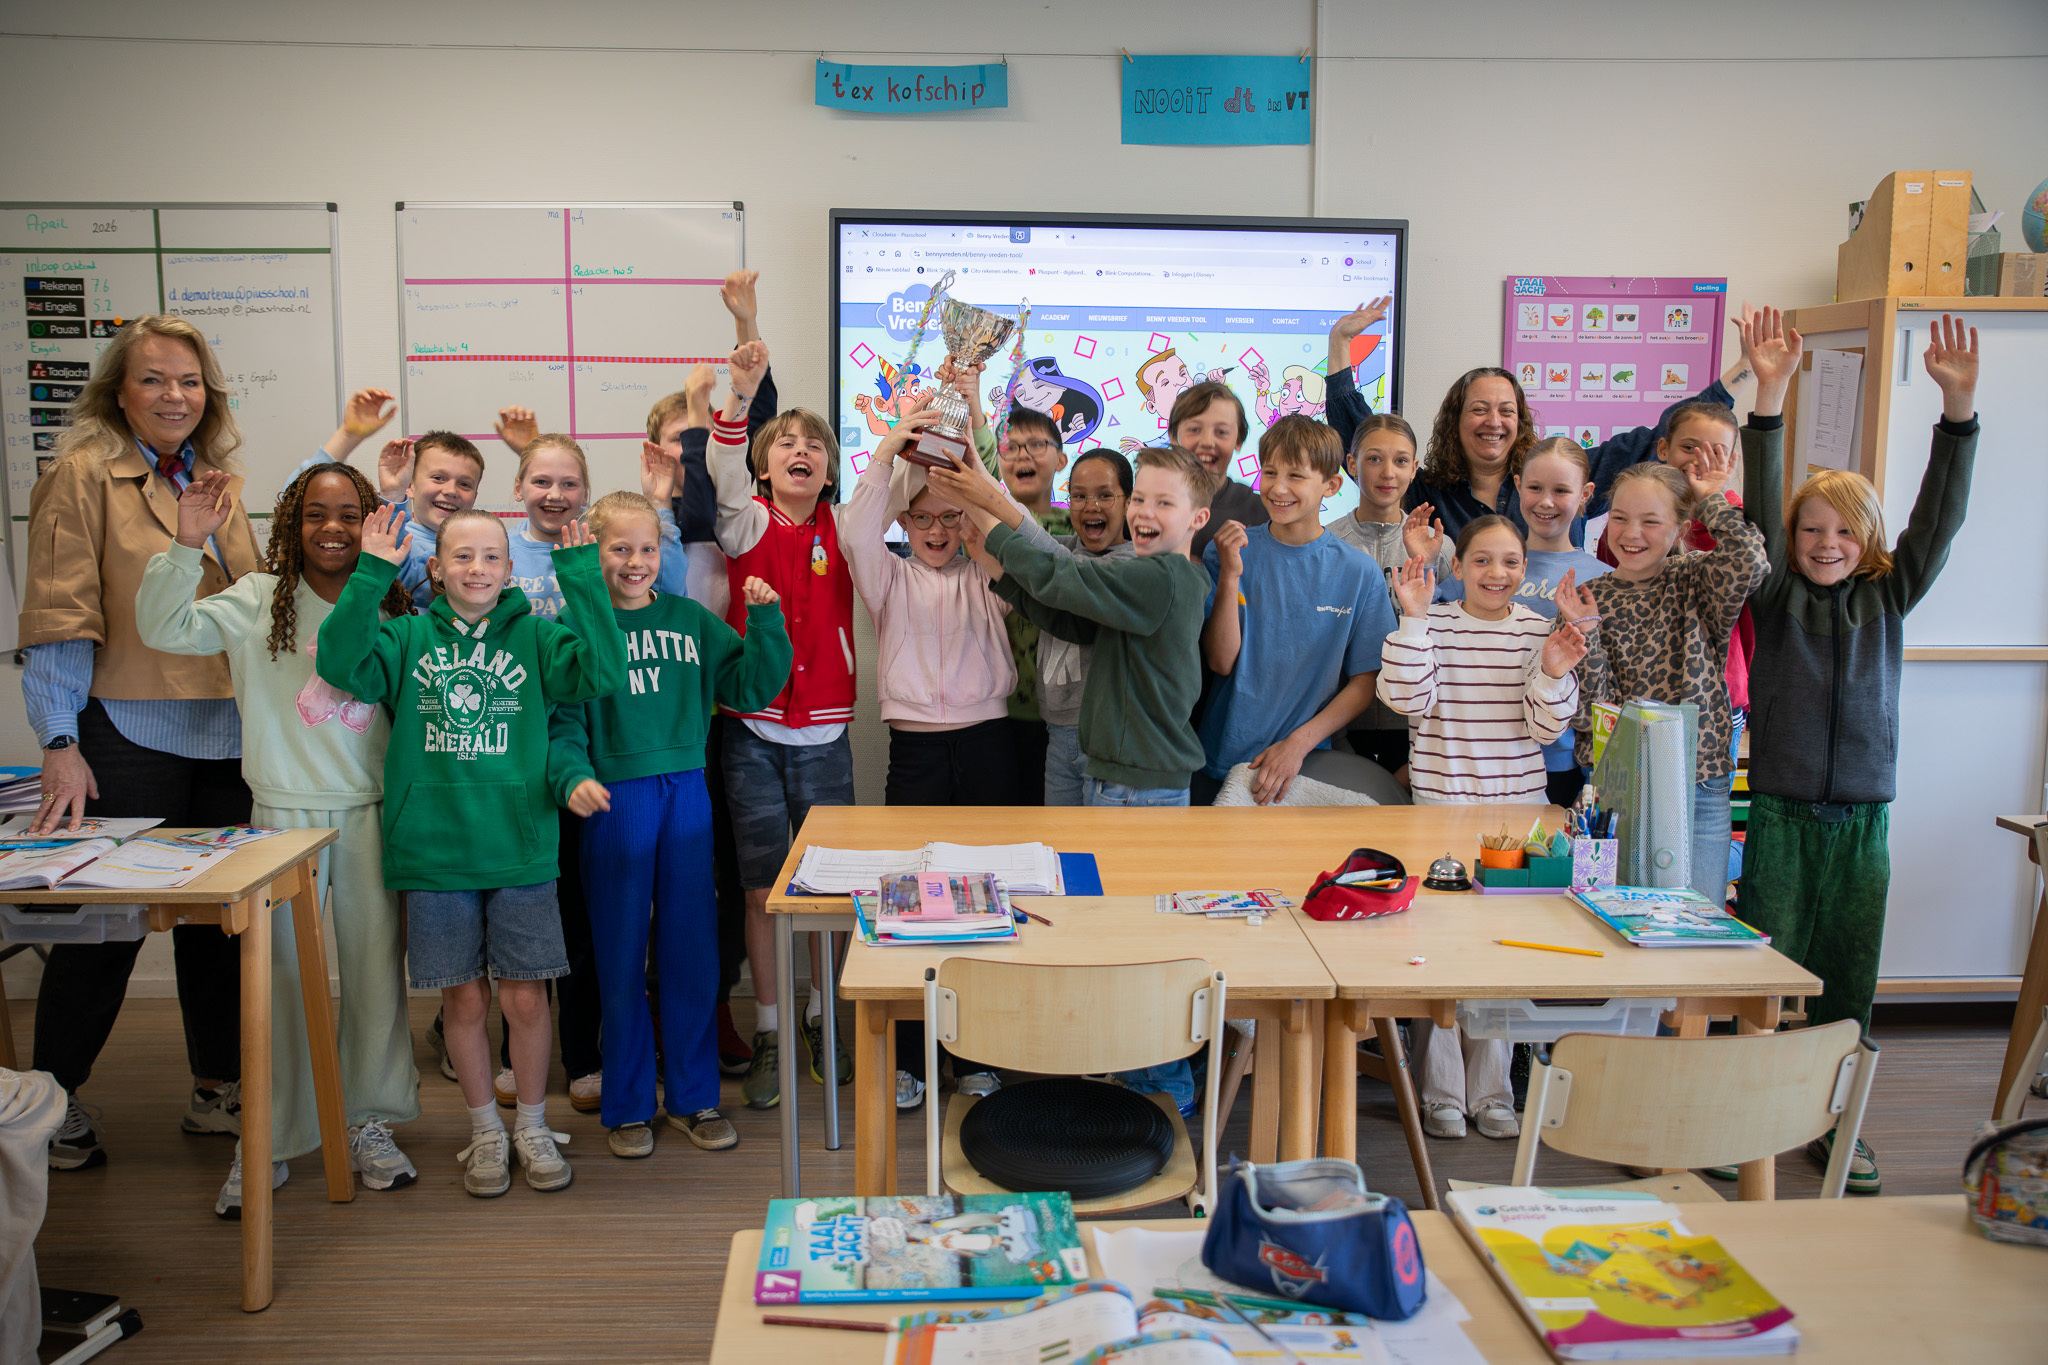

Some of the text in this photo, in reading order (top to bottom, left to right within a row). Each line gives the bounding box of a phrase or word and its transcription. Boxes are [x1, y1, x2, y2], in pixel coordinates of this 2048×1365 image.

[888, 74, 985, 106] kofschip
[1224, 86, 1256, 114] dt
[1286, 91, 1308, 111] VT
[721, 212, 733, 220] ma
[26, 213, 118, 234] April 2026
[626, 266, 635, 275] 5
[40, 281, 83, 291] Rekenen
[1516, 278, 1544, 287] TAAL
[1515, 286, 1546, 295] JACHT
[1695, 284, 1719, 292] Spelling
[44, 302, 78, 313] Engels
[50, 325, 80, 334] Pauze
[461, 342, 468, 351] 4
[47, 367, 89, 378] Taaljacht
[52, 388, 76, 398] Blink
[412, 641, 527, 691] IRELAND
[629, 667, 660, 695] NY
[425, 722, 508, 752] EMERALD
[457, 752, 477, 760] ISLE
[809, 1218, 836, 1261] TAAL
[837, 1215, 865, 1262] JACHT
